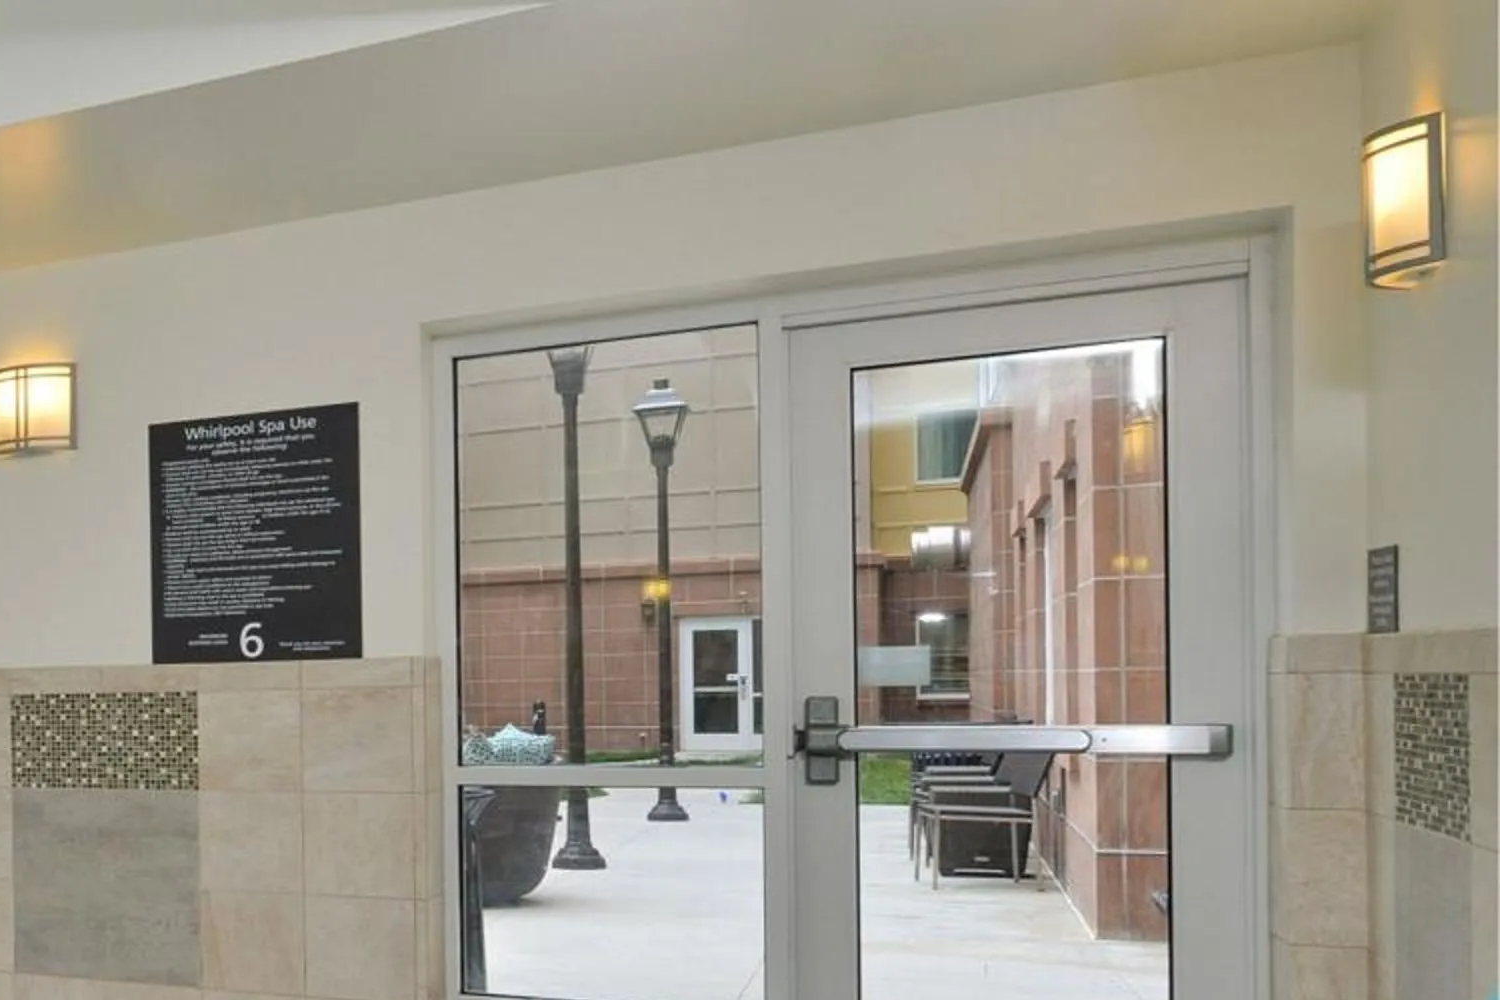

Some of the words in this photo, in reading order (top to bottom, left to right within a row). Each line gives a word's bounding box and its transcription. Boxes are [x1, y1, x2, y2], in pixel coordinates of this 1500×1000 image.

[185, 420, 255, 441] Whirlpool
[258, 418, 285, 435] Spa
[289, 416, 317, 431] Use
[239, 621, 265, 658] 6
